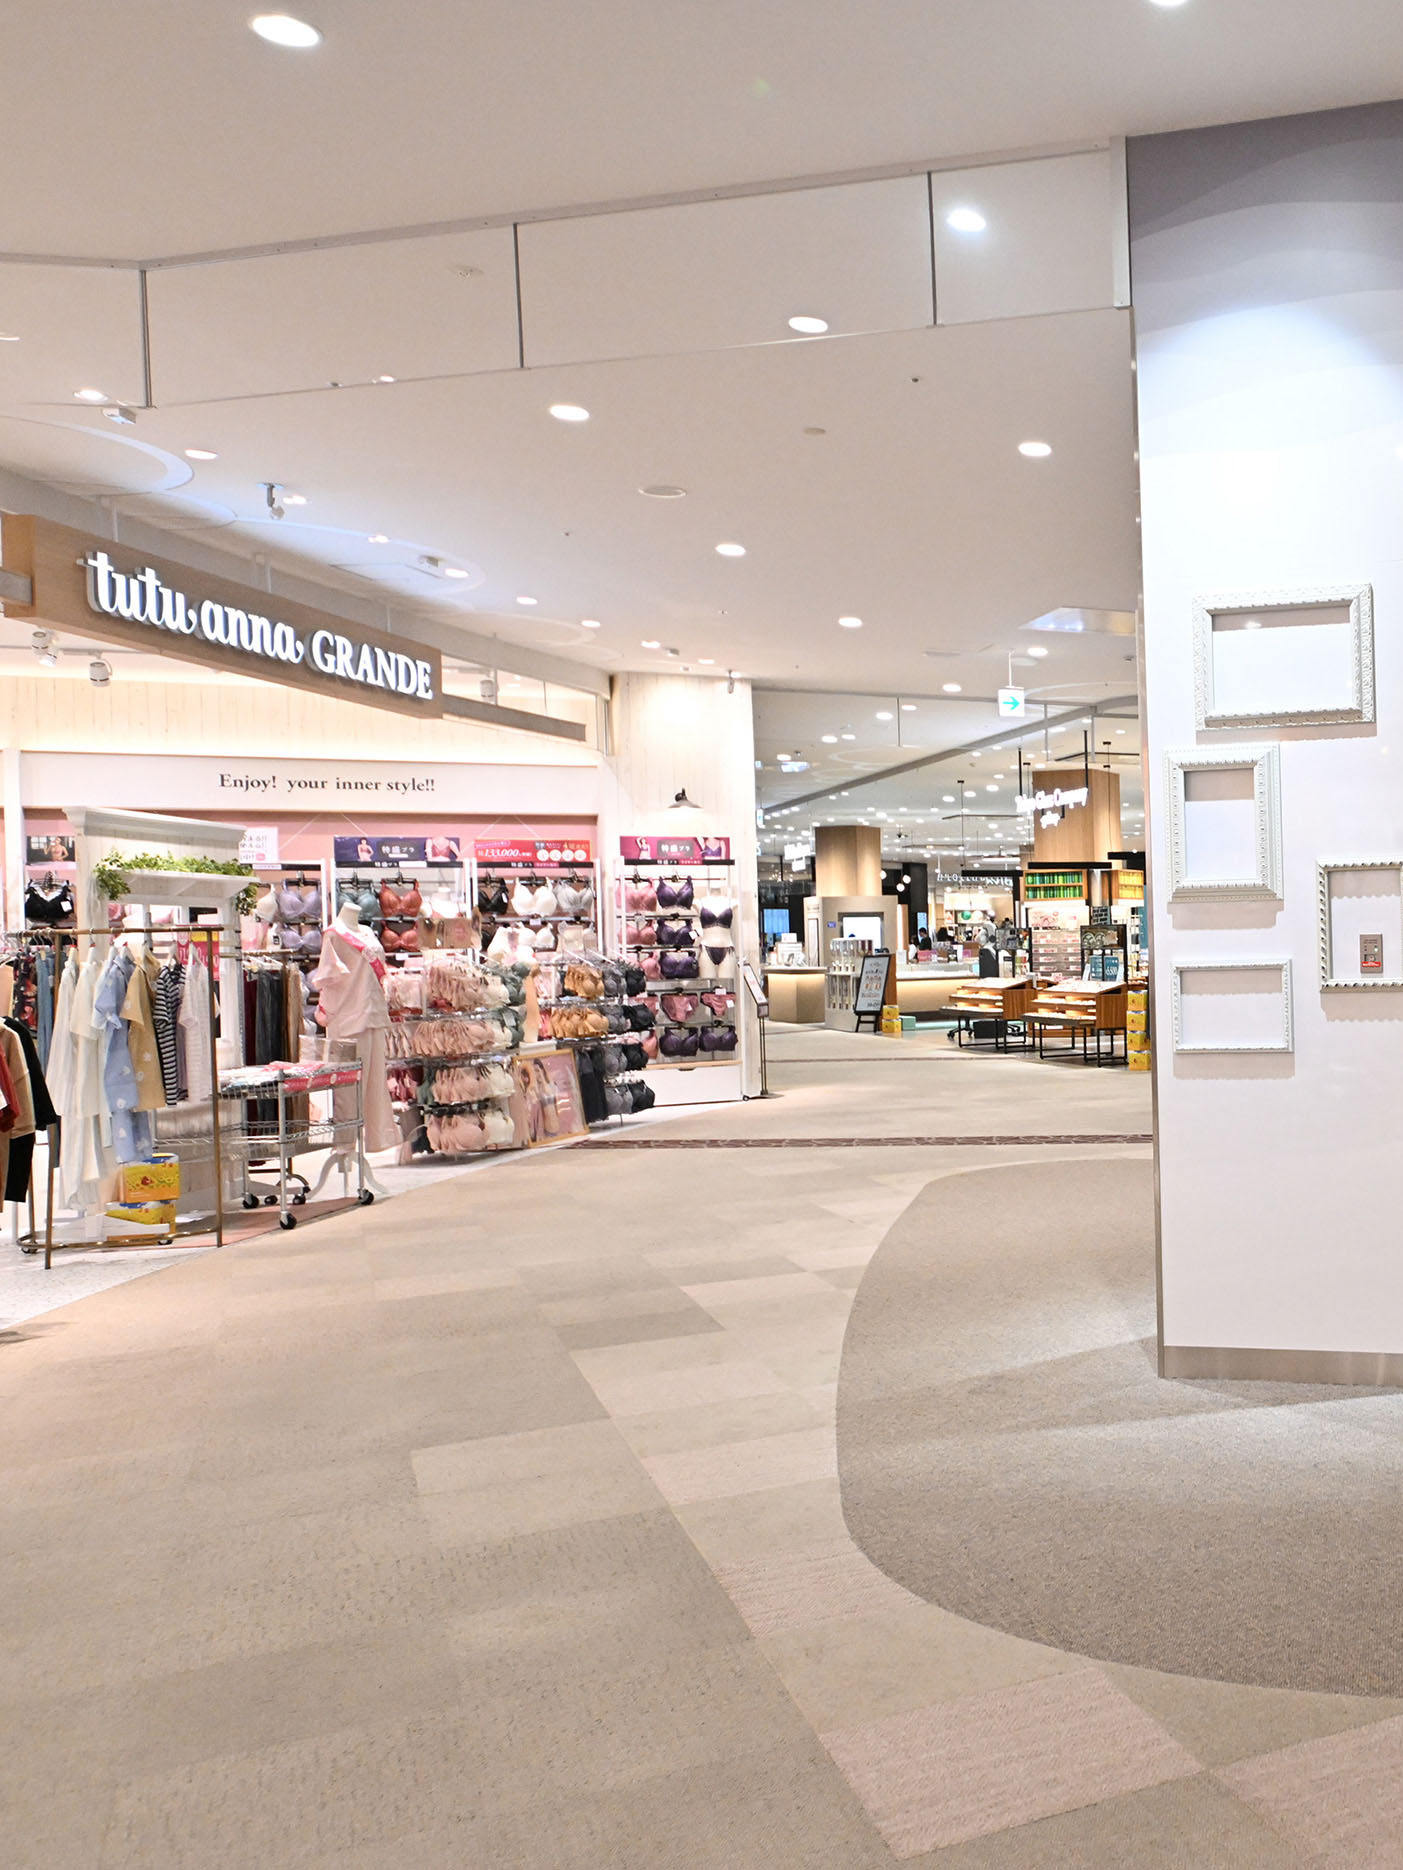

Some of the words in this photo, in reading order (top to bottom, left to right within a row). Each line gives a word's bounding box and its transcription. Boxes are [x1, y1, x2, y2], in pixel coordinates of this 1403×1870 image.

[311, 629, 434, 700] GRANDE
[218, 773, 277, 792] Enjoy!
[286, 778, 329, 793] your
[335, 776, 382, 792] inner
[385, 777, 436, 795] style!!
